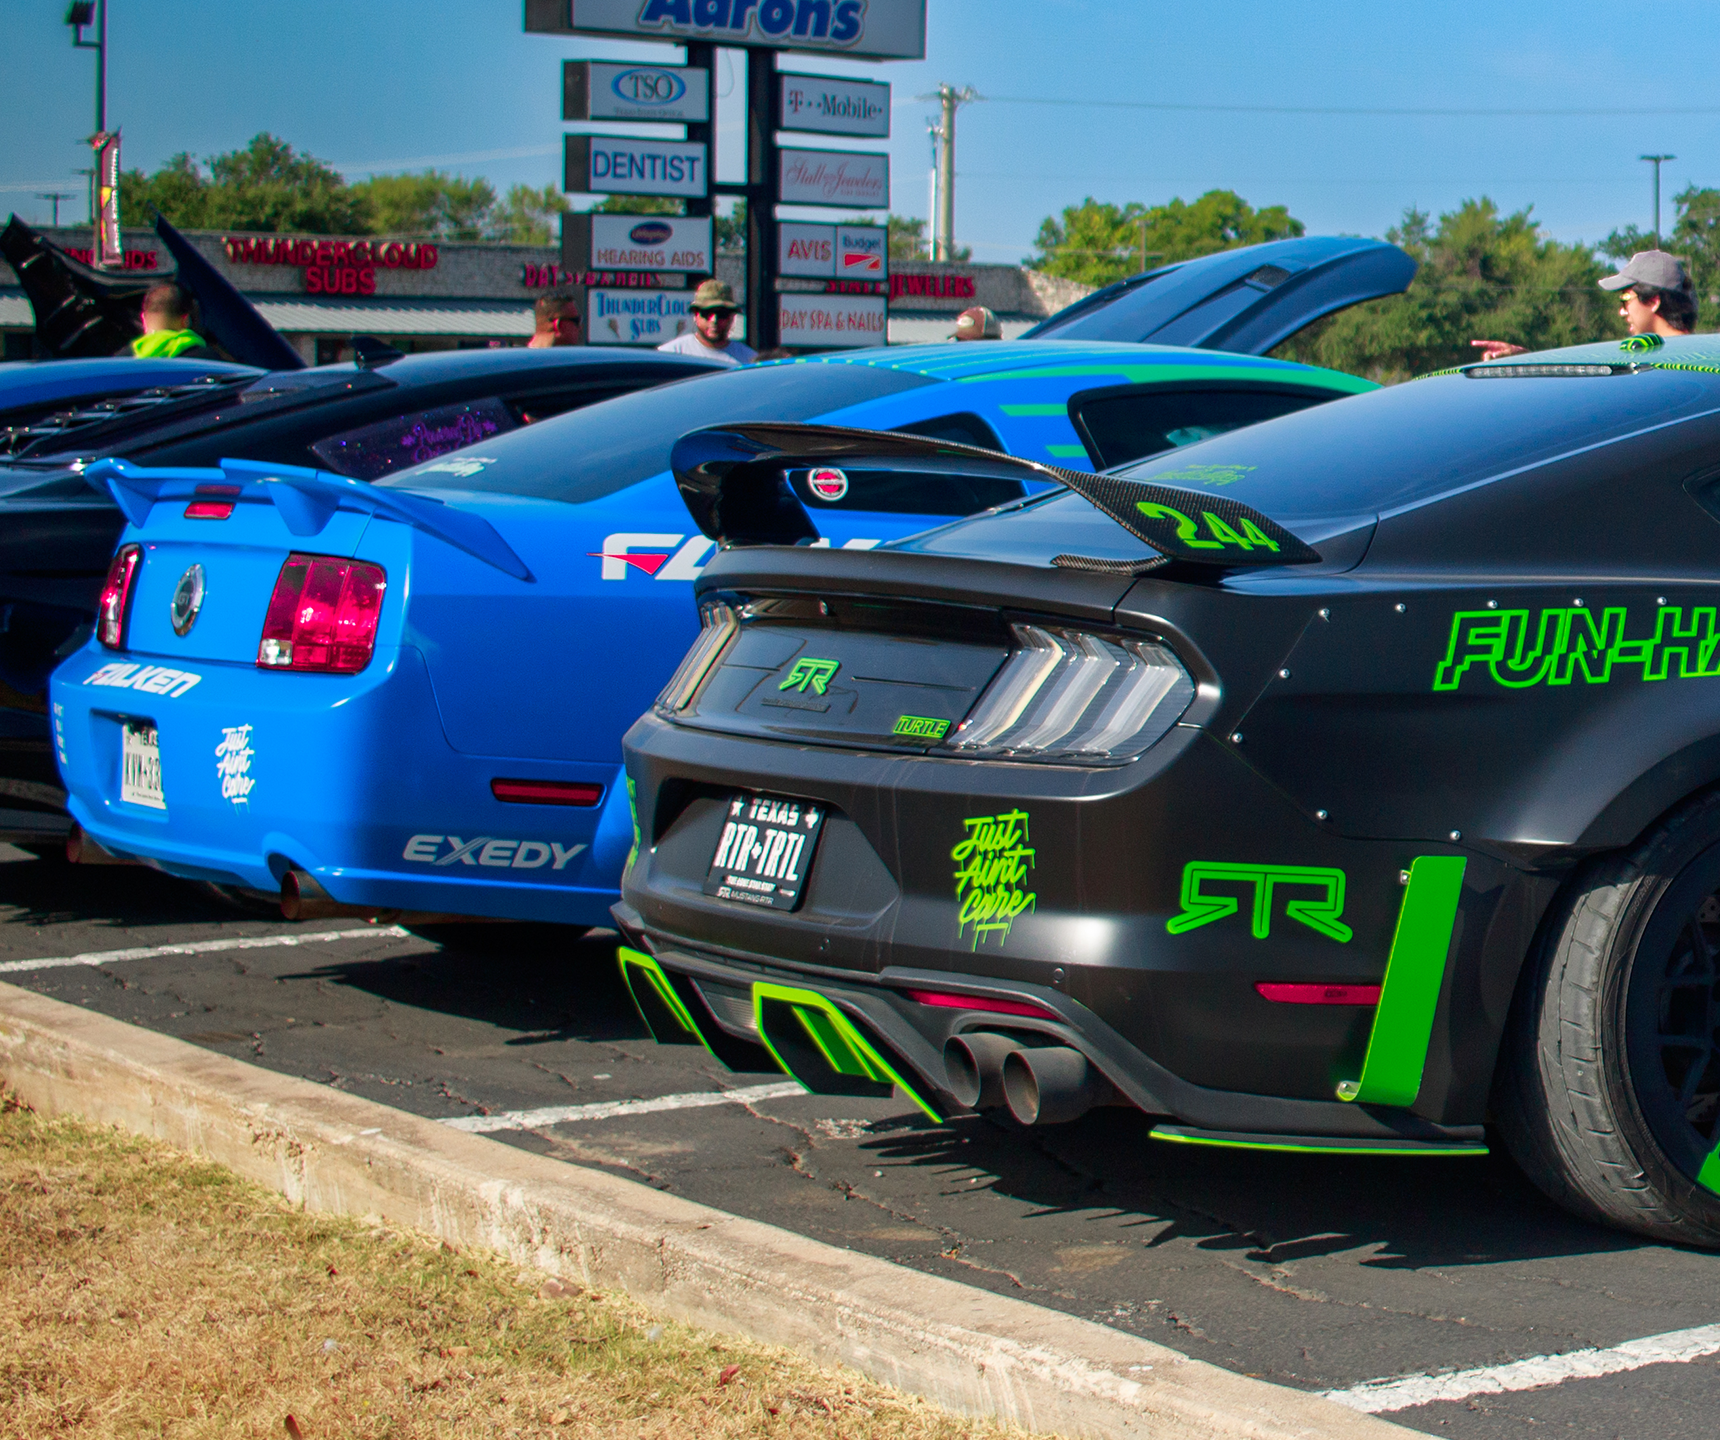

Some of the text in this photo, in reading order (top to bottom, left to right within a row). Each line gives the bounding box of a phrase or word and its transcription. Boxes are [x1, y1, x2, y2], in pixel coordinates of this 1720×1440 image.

[639, 0, 861, 42] Aarons
[629, 74, 674, 100] TSO
[592, 150, 700, 182] DENTIST
[222, 237, 438, 269] THUNDERCLOUD
[788, 239, 832, 262] AVIS
[842, 234, 881, 252] Budget
[597, 249, 705, 267] HEARING AIDS
[306, 266, 376, 294] SUBS
[888, 274, 976, 300] JEWELERS
[596, 292, 697, 317] THUNDERCLOU
[629, 318, 661, 340] SUBS
[780, 309, 884, 333] DAY SPA & NAILS
[1136, 502, 1281, 552] 244
[83, 663, 202, 698] FALKEN
[215, 723, 253, 757] Just
[900, 717, 948, 737] TURTLE
[749, 797, 800, 827] TEXAS
[951, 808, 1030, 861] Just
[402, 834, 588, 870] EXEDY
[731, 890, 761, 903] MUSTANG
[960, 884, 1037, 923] Care
